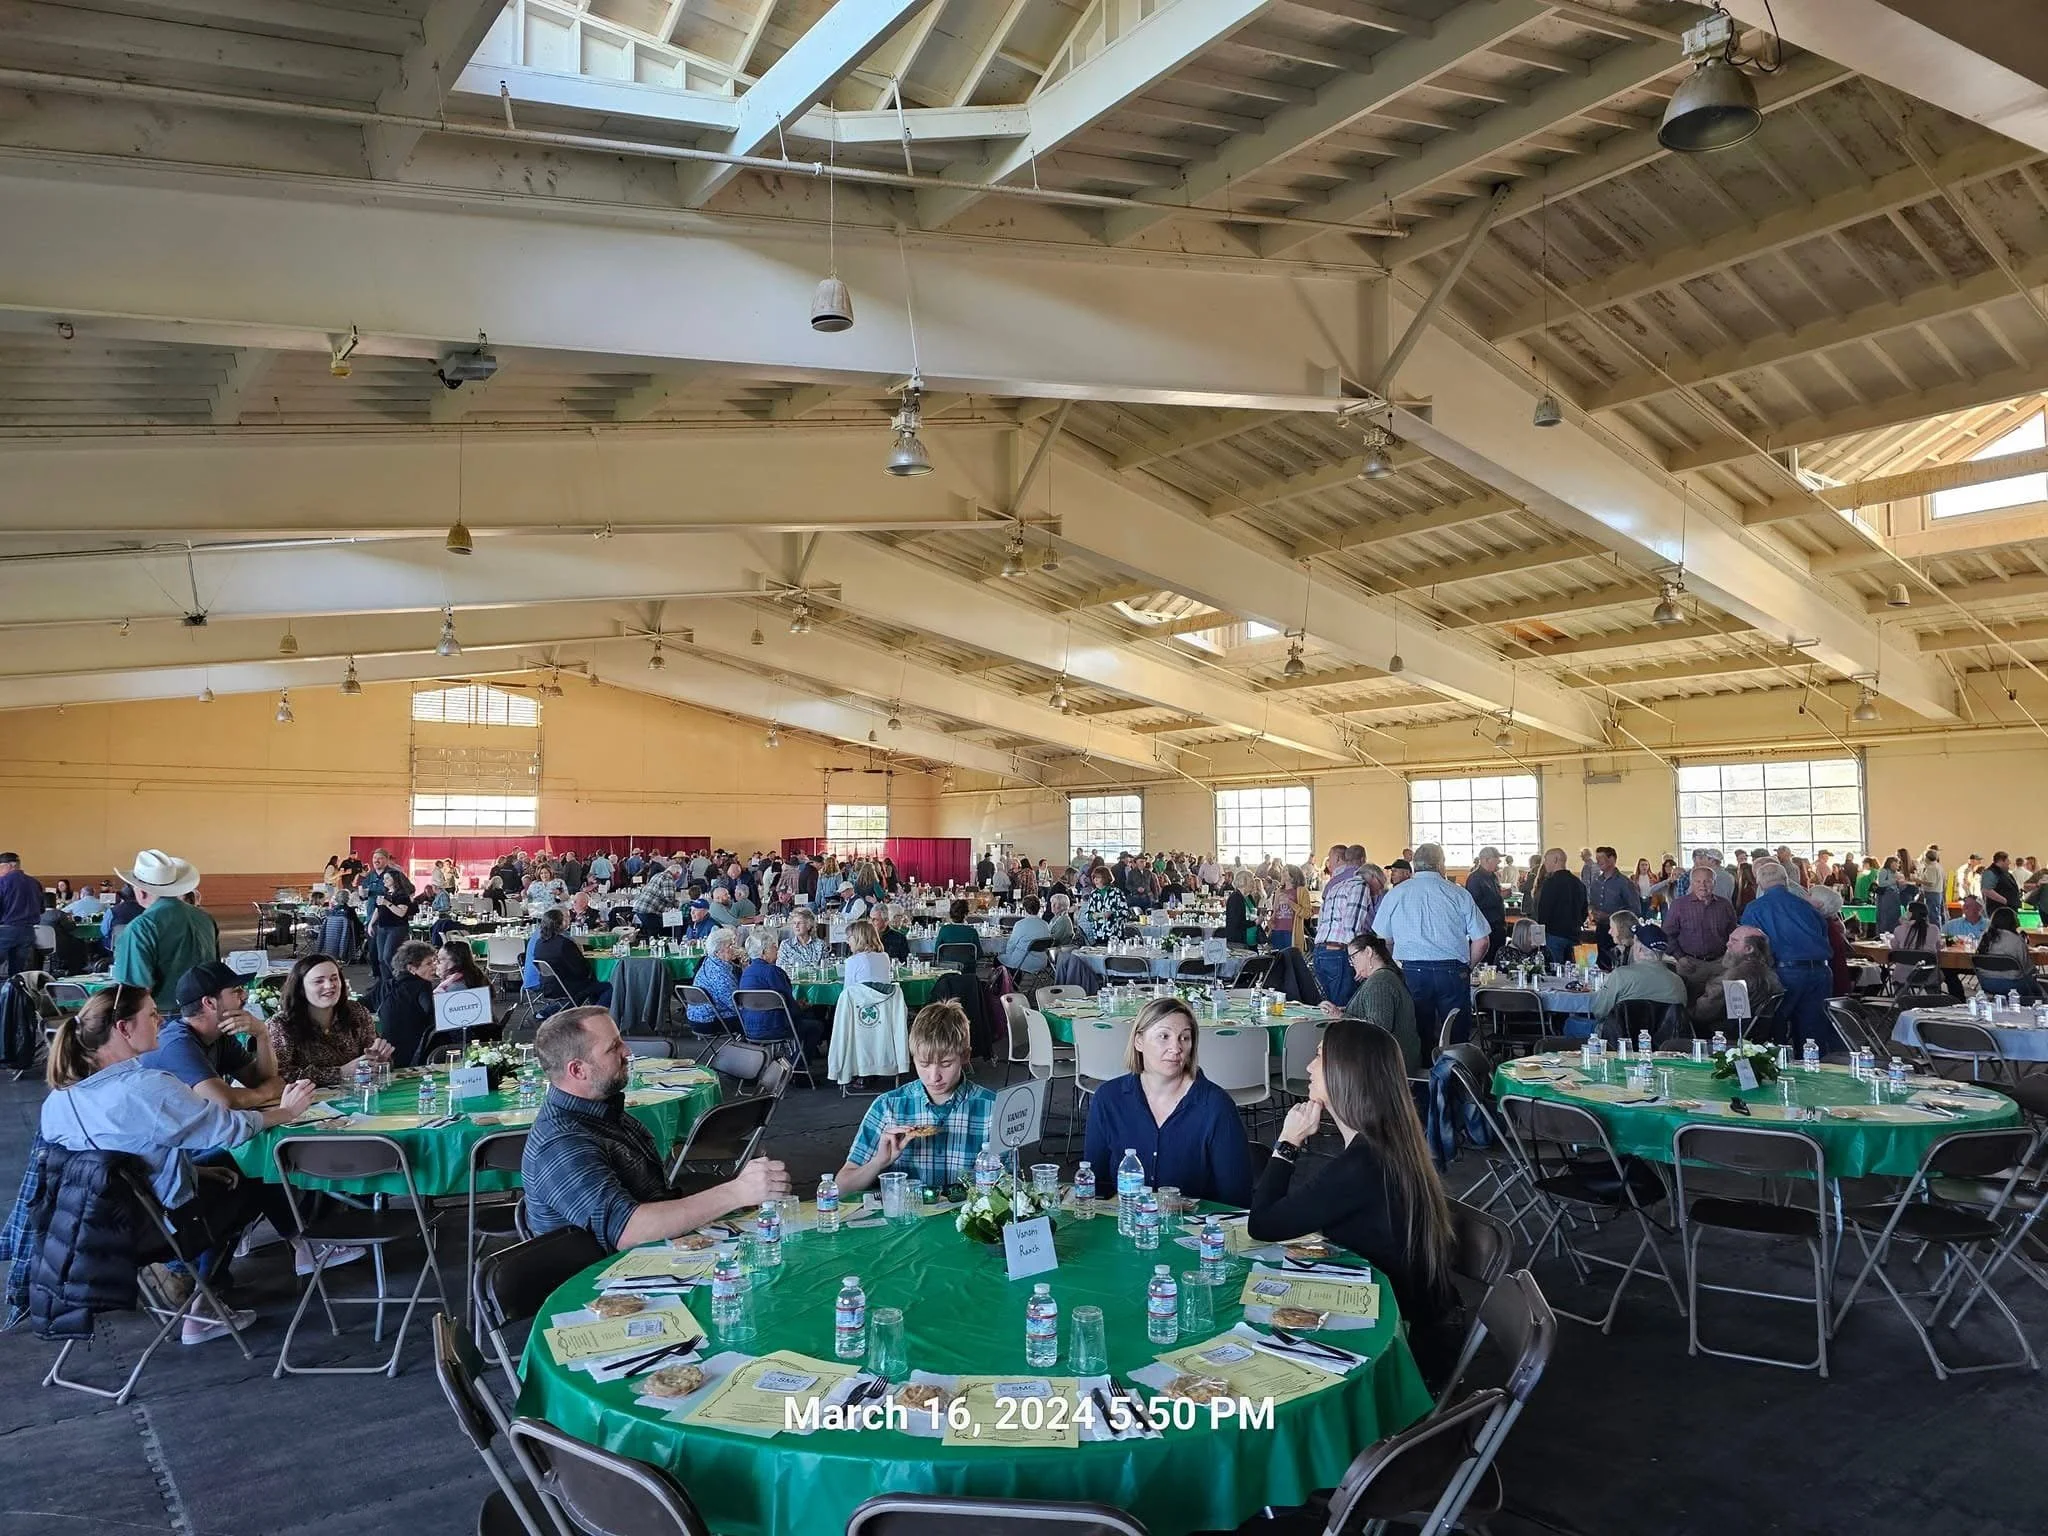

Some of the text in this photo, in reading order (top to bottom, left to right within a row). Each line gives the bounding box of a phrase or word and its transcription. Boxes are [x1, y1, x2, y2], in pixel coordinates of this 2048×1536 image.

[448, 1003, 479, 1013] BARTLETT
[1007, 1108, 1029, 1122] VANONI
[1006, 1122, 1025, 1136] RANCH
[1018, 1244, 1041, 1257] Ranch
